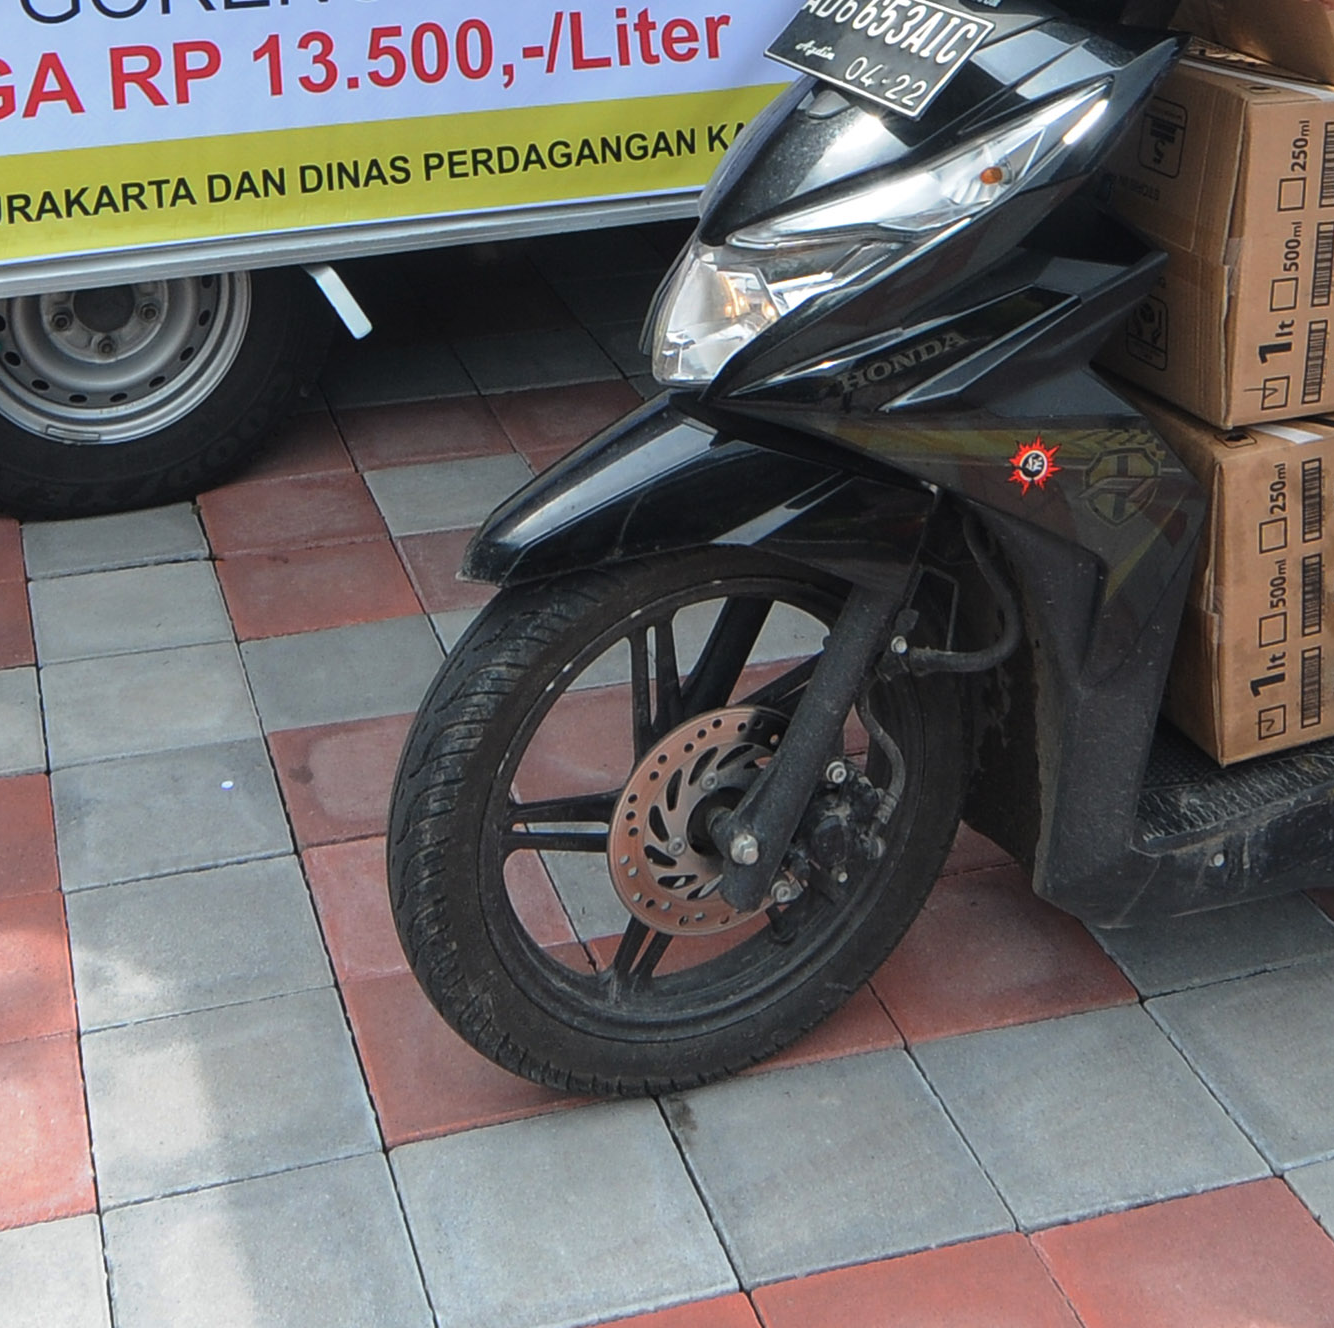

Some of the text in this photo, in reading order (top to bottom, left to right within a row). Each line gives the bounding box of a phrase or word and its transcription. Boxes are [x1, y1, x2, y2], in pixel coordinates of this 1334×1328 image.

[110, 39, 224, 112] RP
[252, 6, 731, 98] 13.500,-/Liter
[205, 165, 289, 205] DAN
[299, 154, 412, 196] DINAS
[422, 126, 696, 182] PERDAGANGAN
[707, 122, 745, 153] K
[1258, 119, 1311, 364] 1lt 500ml 250ml
[839, 331, 968, 393] HONDA
[1250, 463, 1287, 698] 1lt 500ml 250ml
